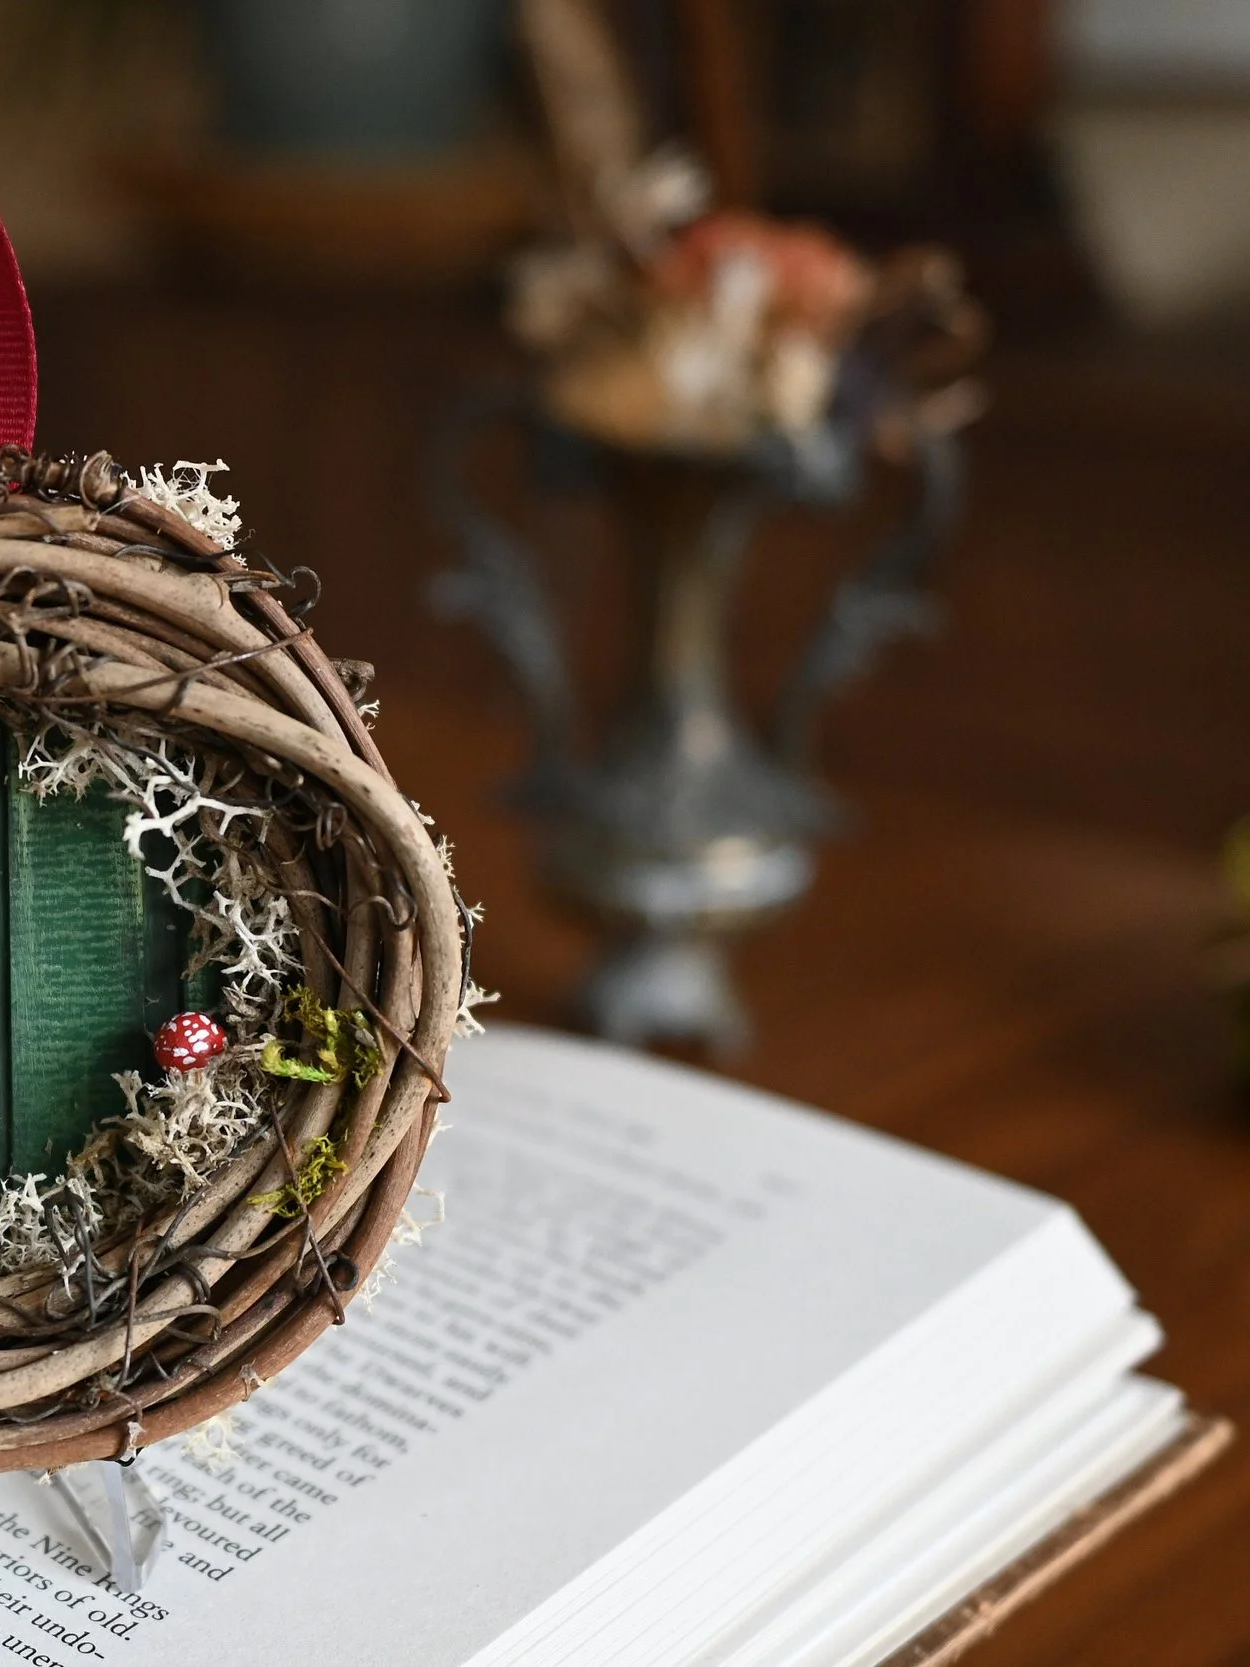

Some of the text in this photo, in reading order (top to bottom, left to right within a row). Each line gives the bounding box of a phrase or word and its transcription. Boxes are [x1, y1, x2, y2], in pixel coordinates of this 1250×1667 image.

[253, 1430, 377, 1488] greed of
[235, 1479, 279, 1502] of
[267, 1497, 313, 1525] the
[272, 1468, 340, 1507] came
[205, 1494, 253, 1526] but
[248, 1521, 293, 1545] all
[30, 1535, 94, 1578] Nine
[177, 1552, 235, 1582] and
[30, 1613, 105, 1660] undo-
[53, 1590, 96, 1610] of
[88, 1611, 139, 1642] old.
